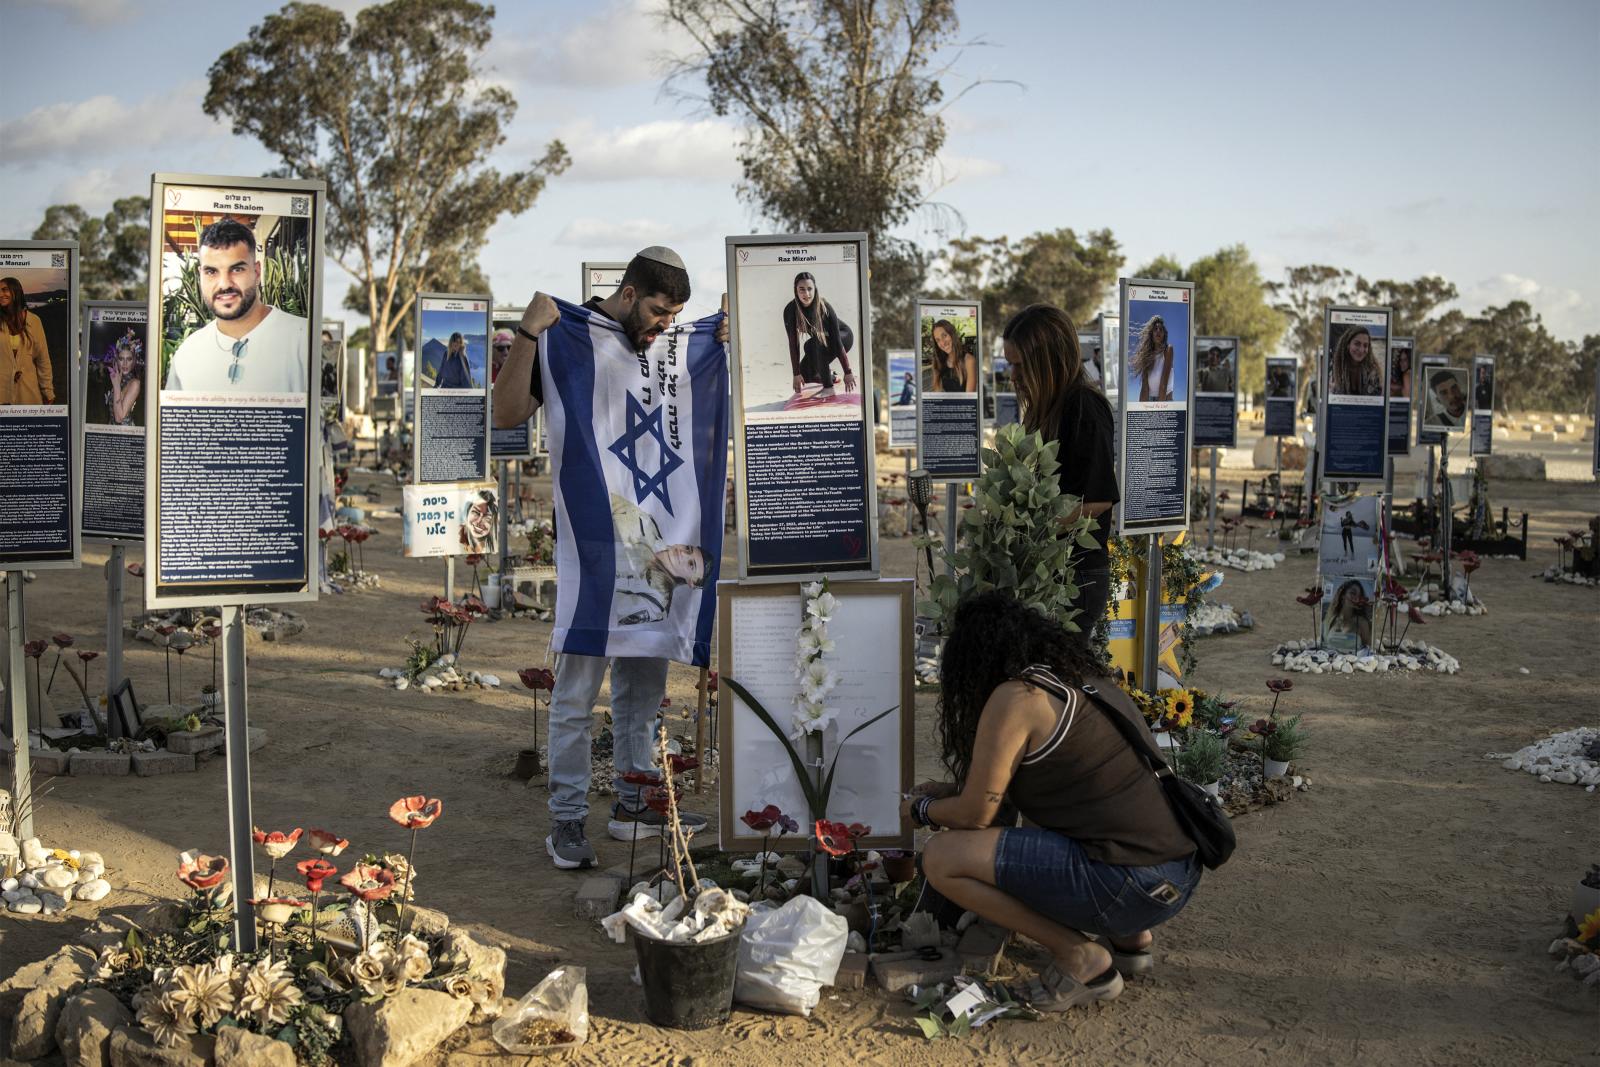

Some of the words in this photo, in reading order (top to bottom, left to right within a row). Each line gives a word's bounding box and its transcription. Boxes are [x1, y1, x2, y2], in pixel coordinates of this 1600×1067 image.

[637, 352, 650, 378] מזר
[658, 360, 667, 396] שלנו
[668, 374, 679, 398] של
[642, 387, 652, 405] רז
[39, 408, 46, 416] by
[669, 405, 682, 450] לזכרה
